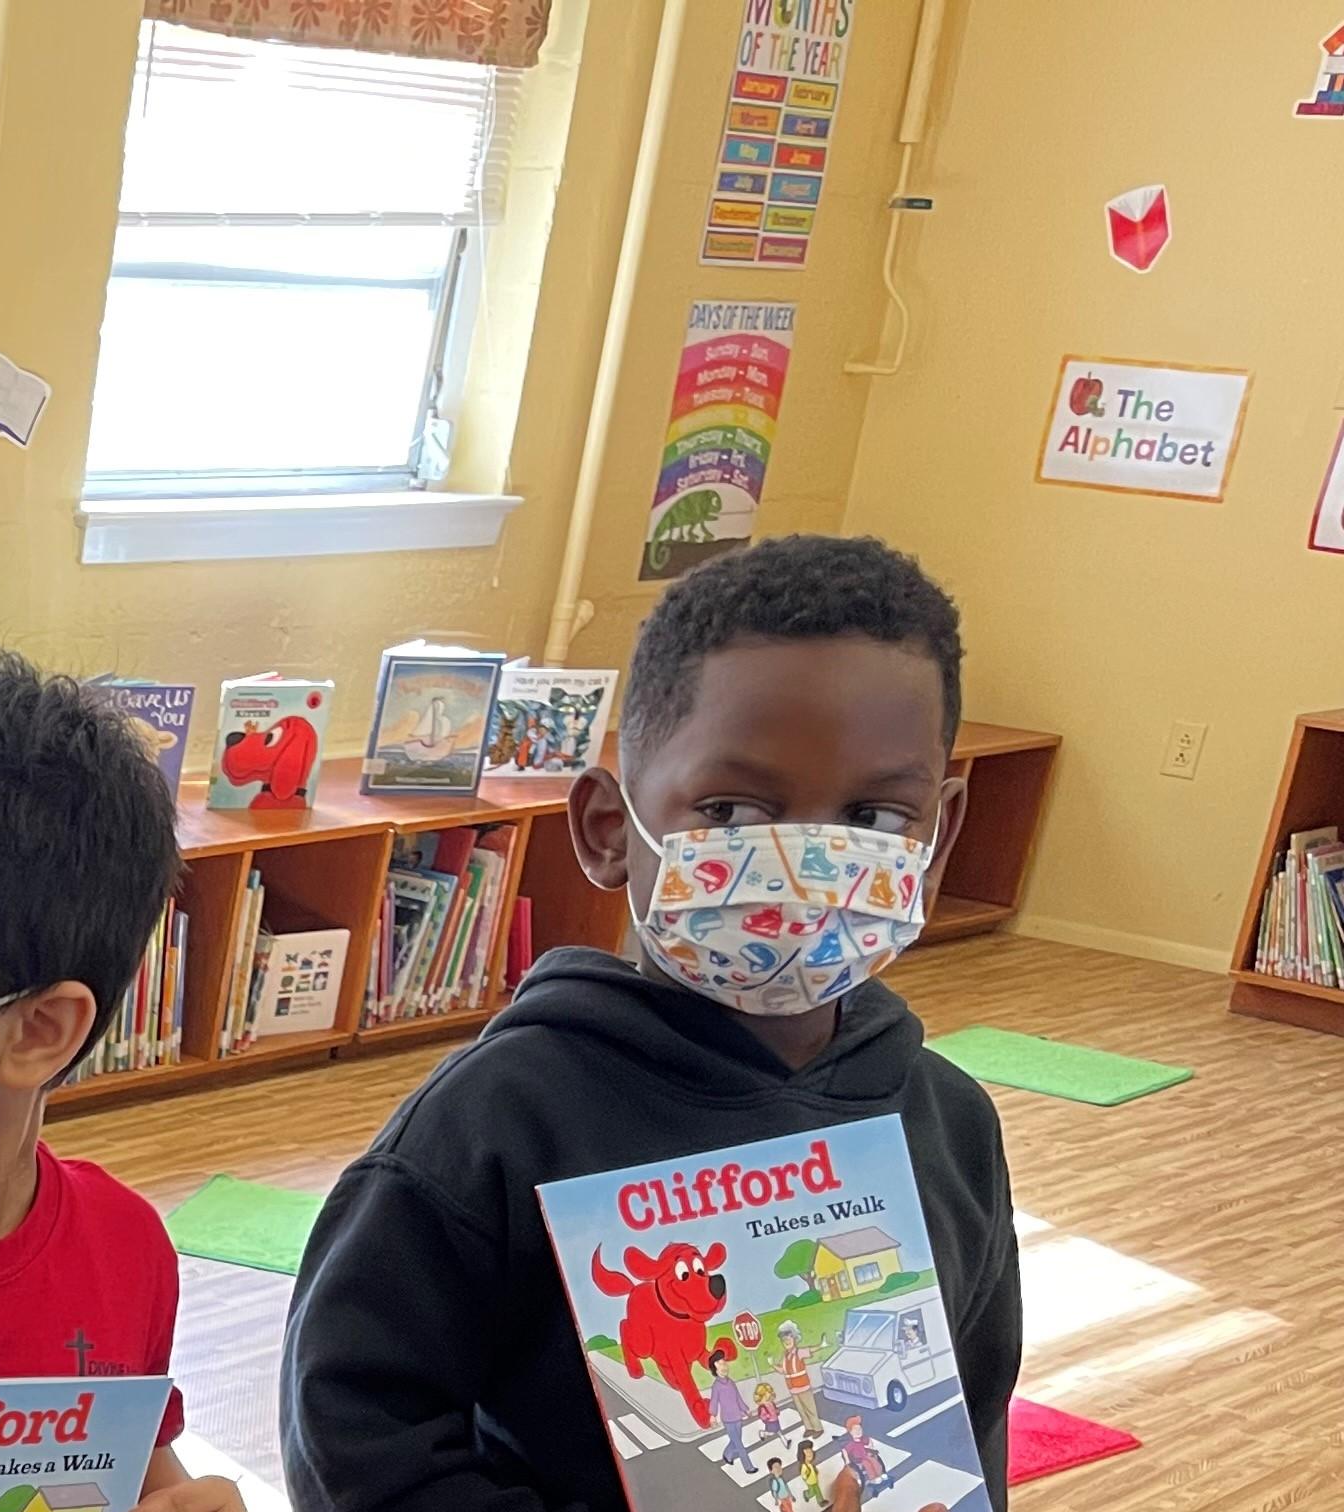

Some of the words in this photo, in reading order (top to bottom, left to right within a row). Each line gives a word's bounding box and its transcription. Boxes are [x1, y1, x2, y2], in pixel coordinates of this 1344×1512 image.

[740, 30, 764, 66] OF
[770, 33, 800, 71] THE
[803, 38, 842, 79] YEAR
[689, 304, 722, 329] DAYS
[723, 305, 739, 329] OF
[740, 305, 762, 330] THE
[763, 306, 795, 331] WEEK
[1117, 389, 1174, 421] The
[1058, 425, 1215, 467] Alphabet
[151, 707, 185, 727] You
[618, 1140, 842, 1232] Clifford
[746, 1215, 810, 1239] Takes
[814, 1212, 825, 1225] a
[827, 1196, 886, 1221] Walk
[735, 1321, 760, 1342] STOP
[45, 1462, 57, 1474] a
[62, 1453, 115, 1472] Walk
